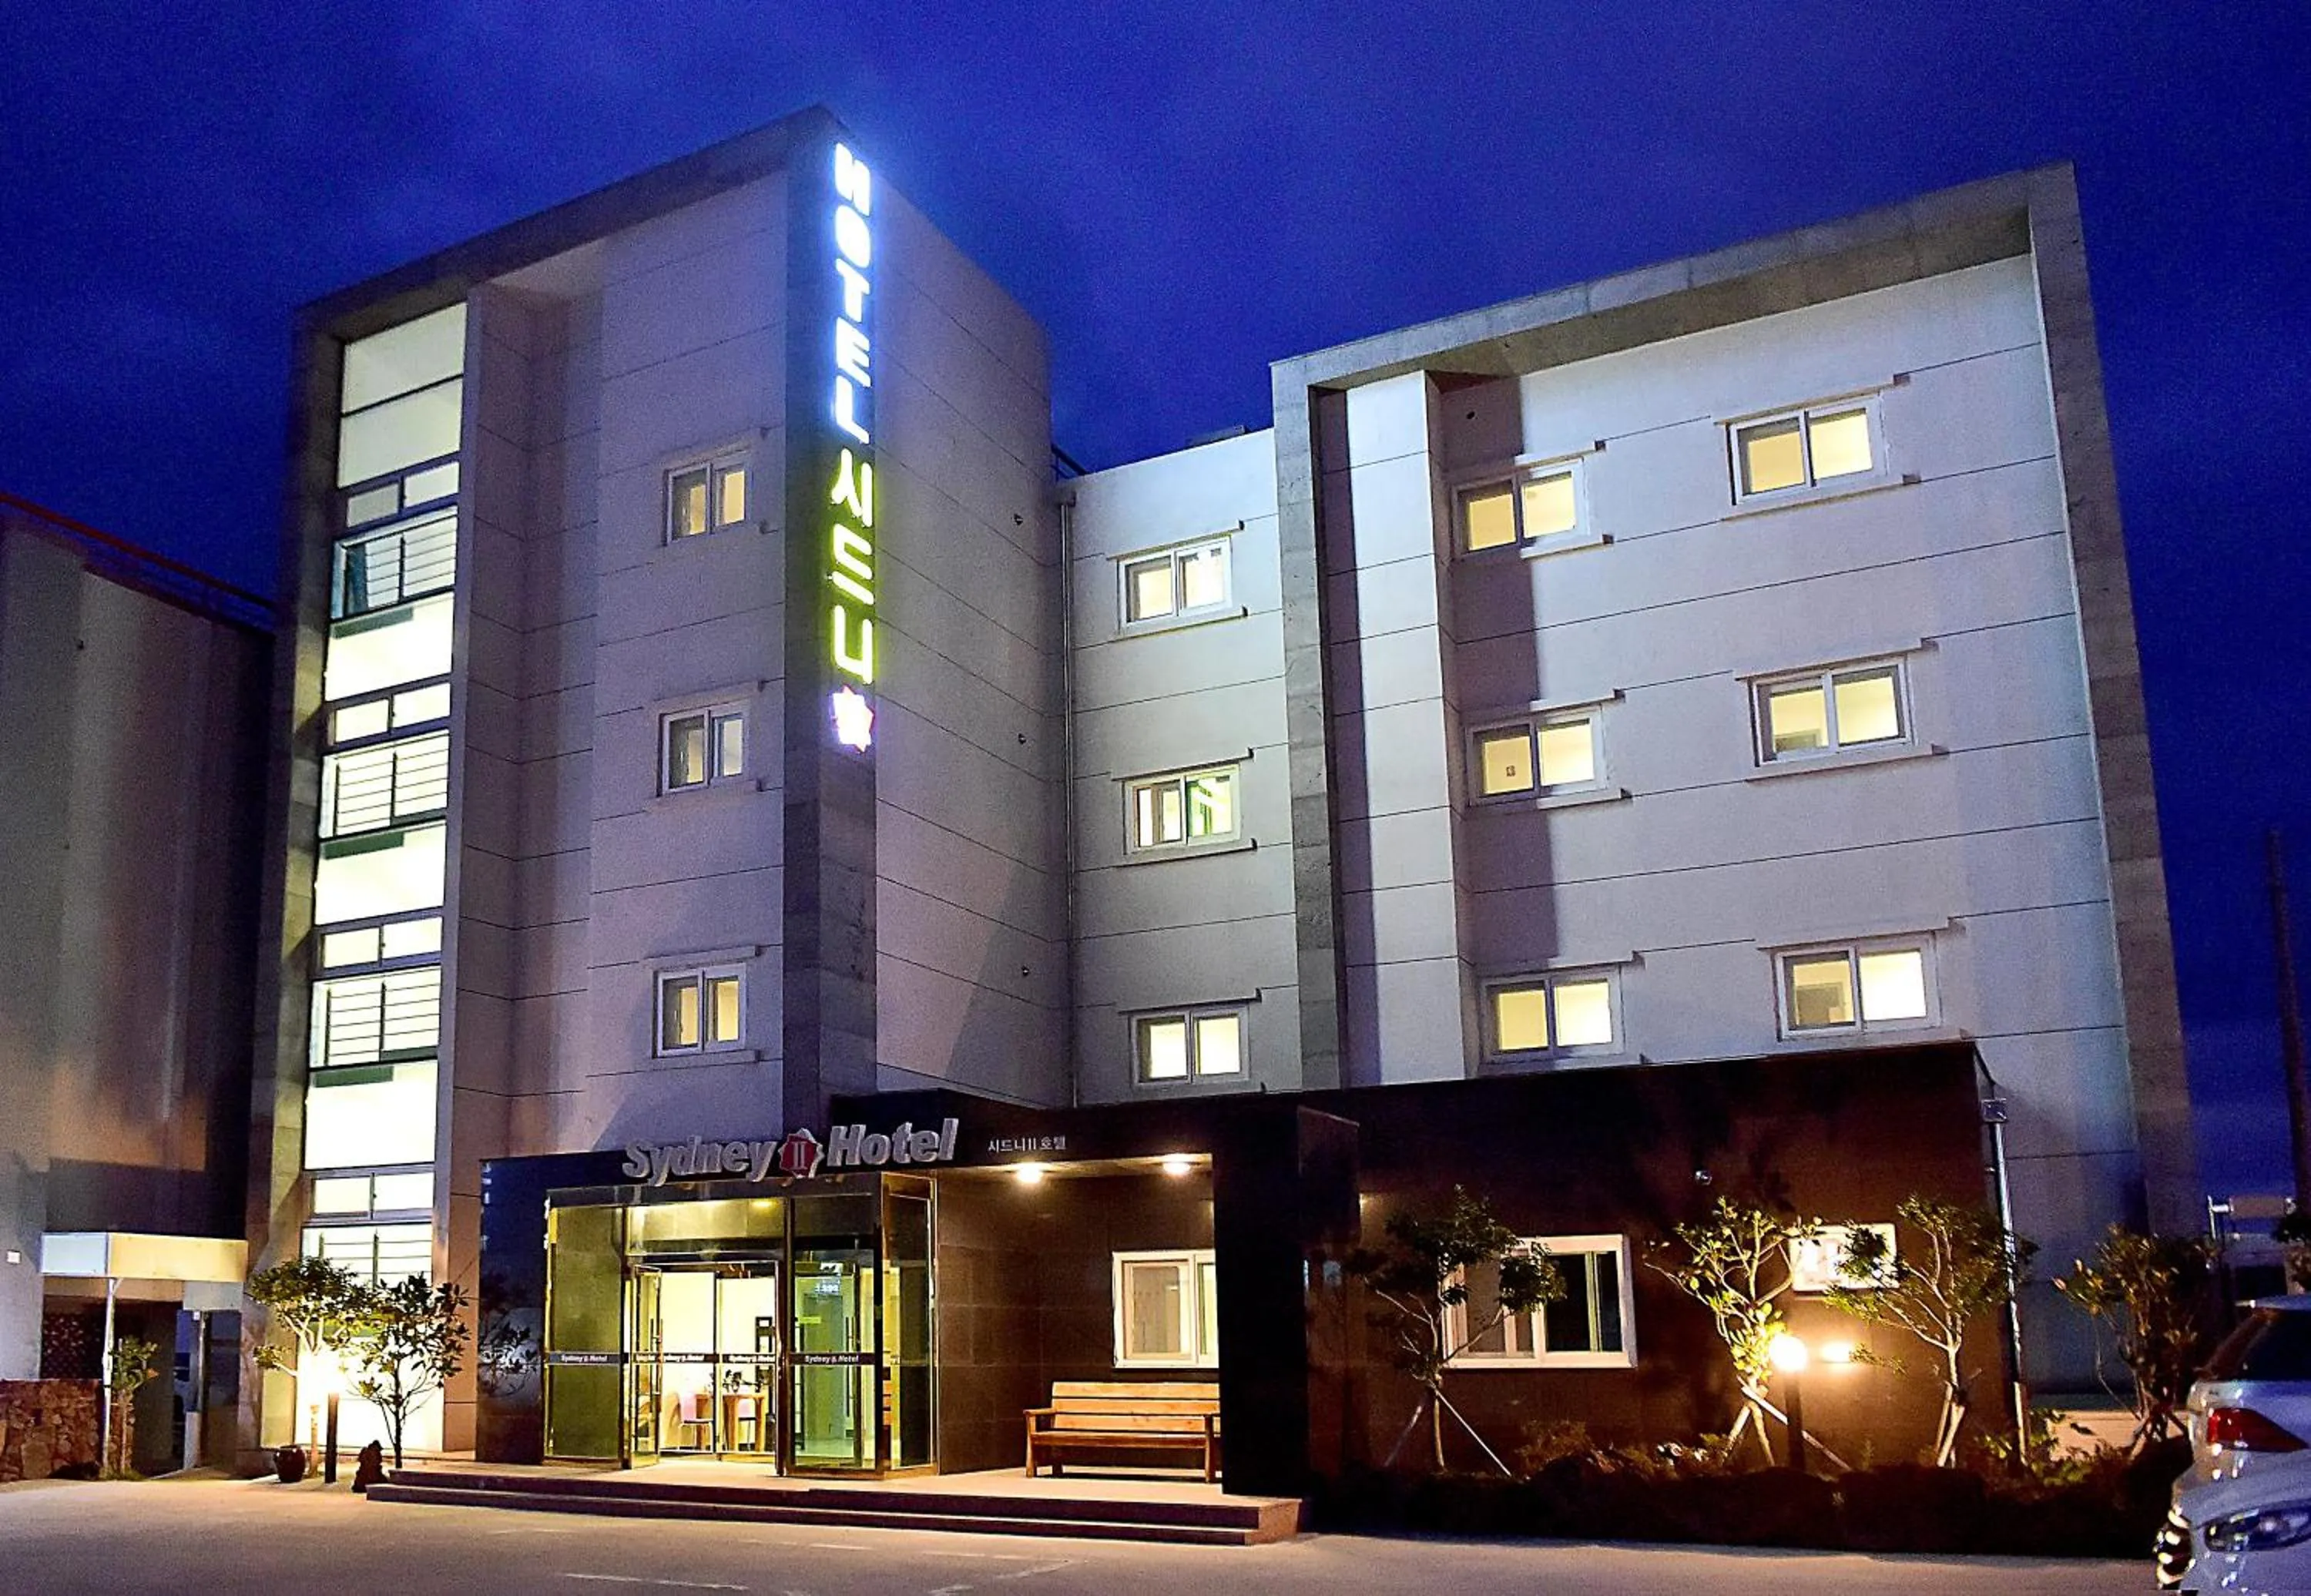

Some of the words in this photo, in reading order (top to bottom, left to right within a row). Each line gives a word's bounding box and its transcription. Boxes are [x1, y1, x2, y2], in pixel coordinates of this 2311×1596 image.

[834, 142, 872, 444] HOTEL
[831, 448, 874, 685] 시드니
[622, 1135, 777, 1187] Sydney
[827, 1118, 959, 1166] Hotel
[805, 1355, 830, 1363] Sydney
